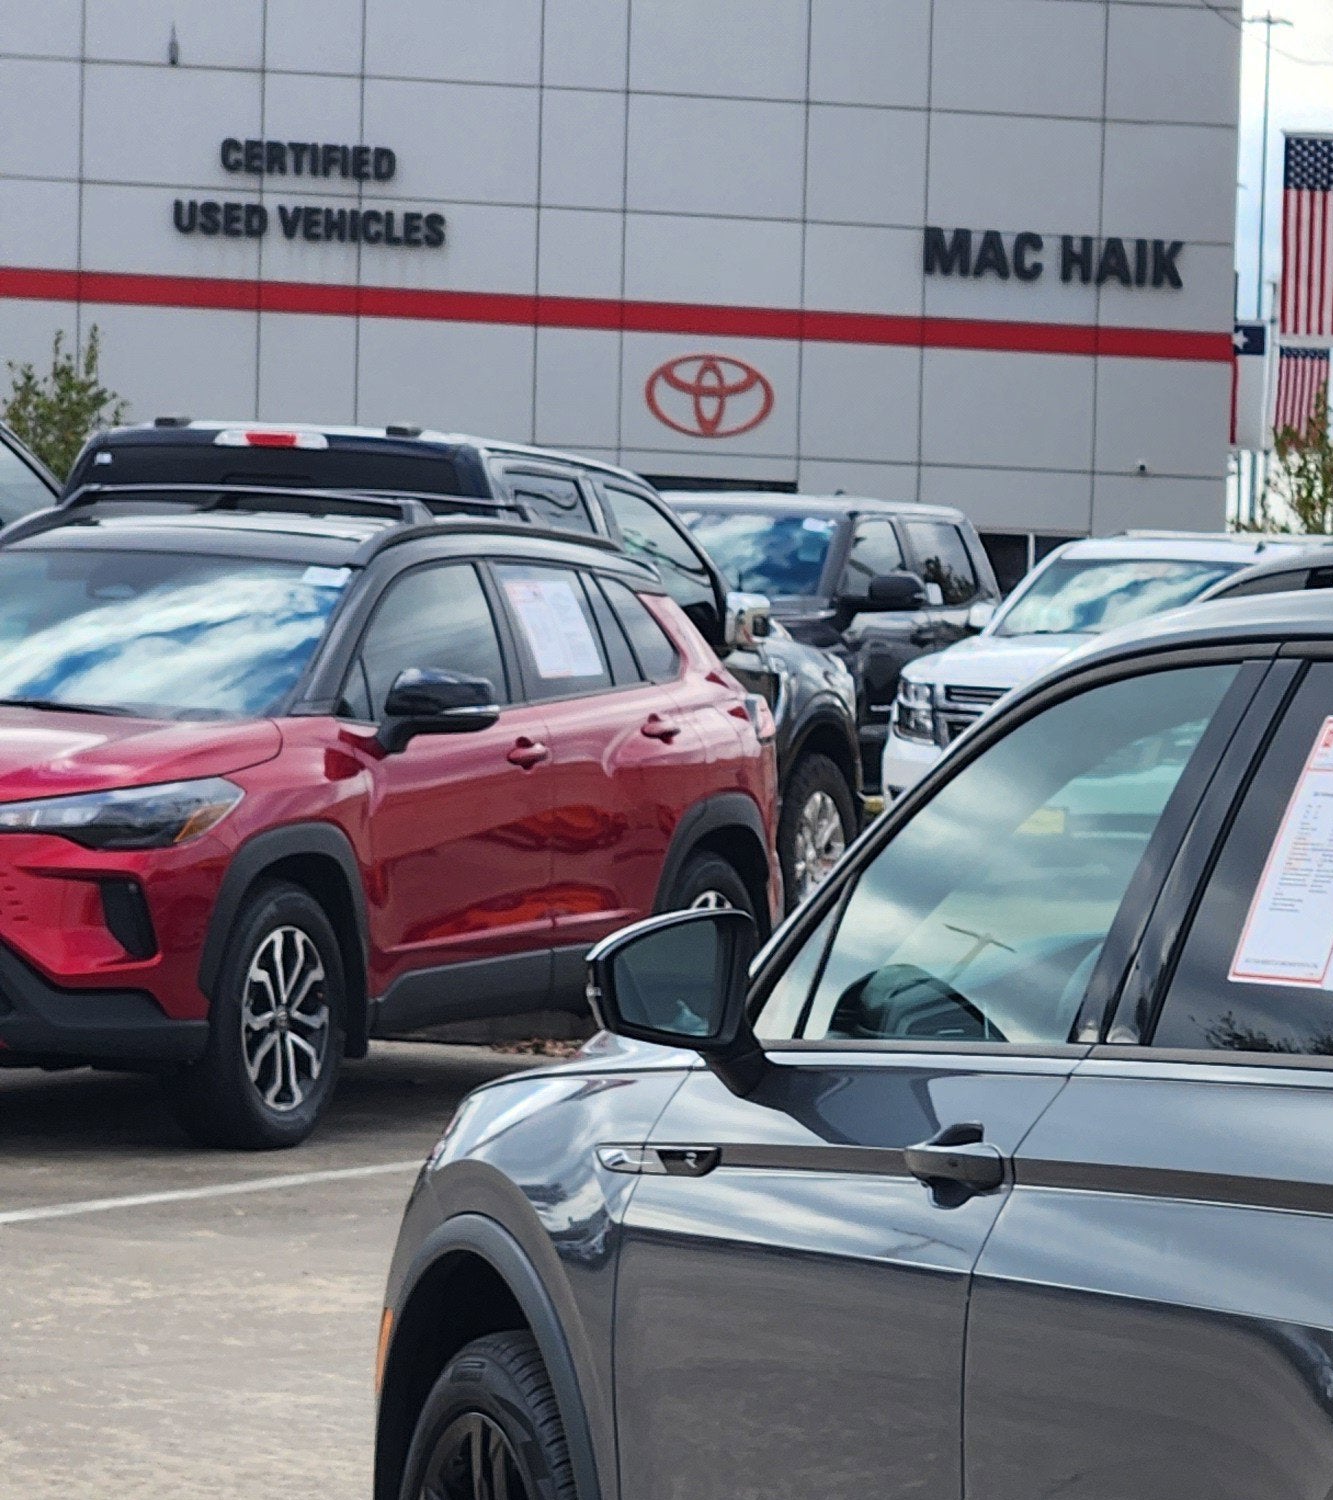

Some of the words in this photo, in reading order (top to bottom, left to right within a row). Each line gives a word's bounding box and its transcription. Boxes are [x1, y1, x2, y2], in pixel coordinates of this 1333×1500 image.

[220, 137, 397, 182] CERTIFIED
[172, 199, 268, 237] USED
[277, 204, 447, 248] VEHICLES
[923, 226, 1044, 281] MAC
[1060, 235, 1185, 289] HAIK
